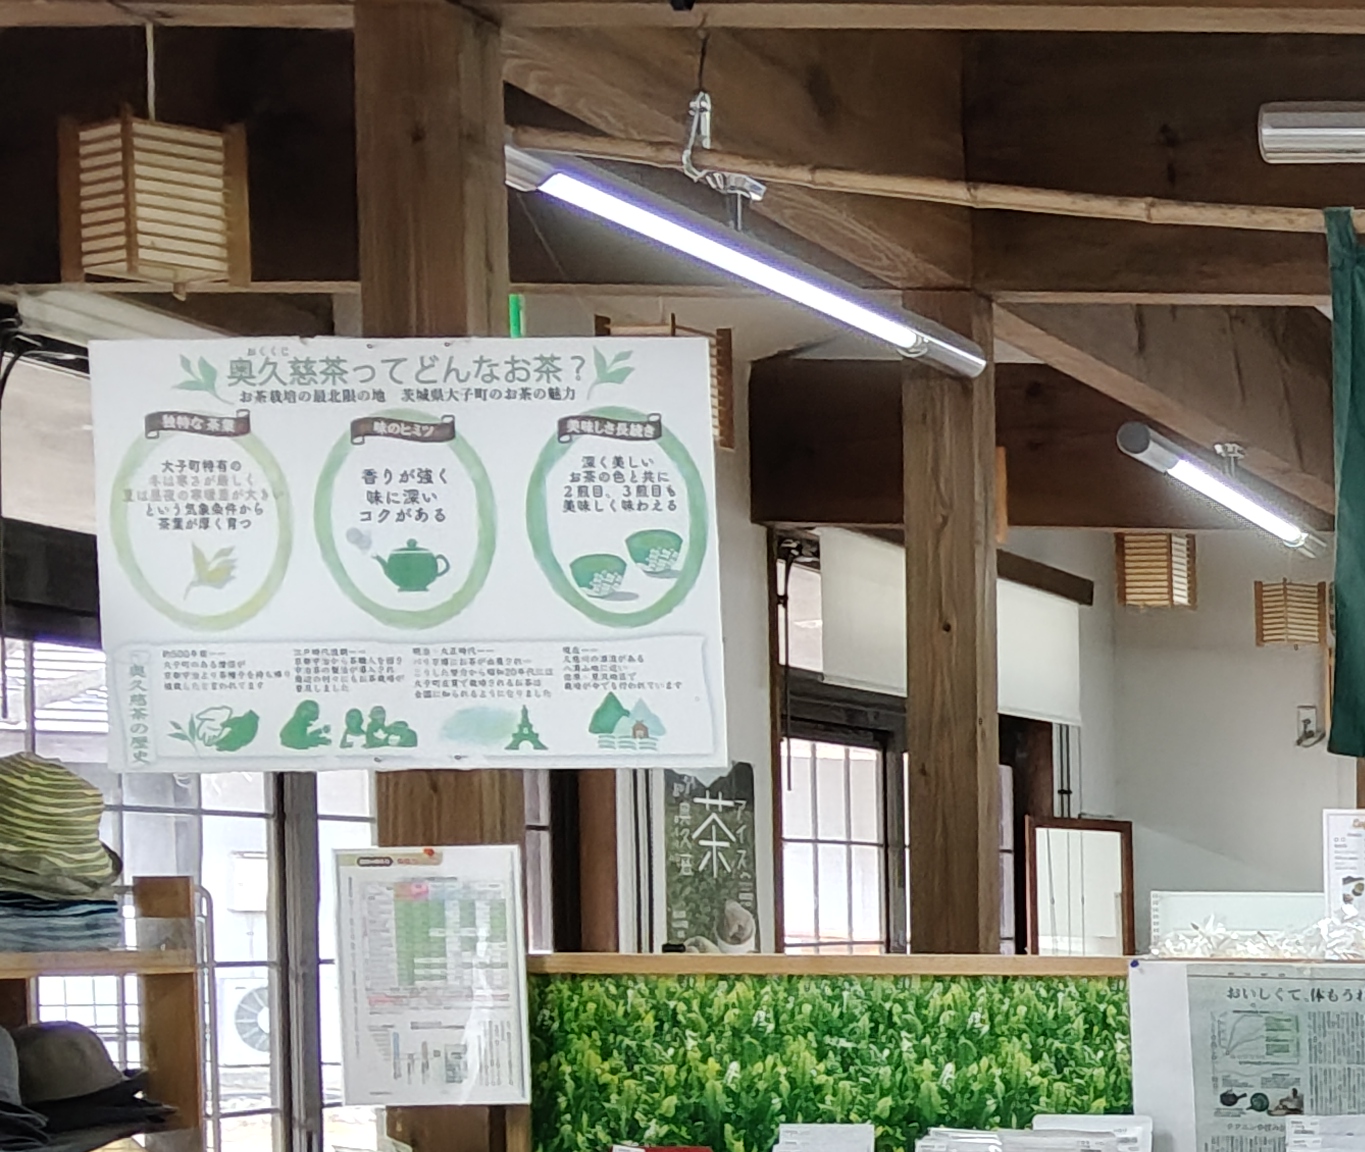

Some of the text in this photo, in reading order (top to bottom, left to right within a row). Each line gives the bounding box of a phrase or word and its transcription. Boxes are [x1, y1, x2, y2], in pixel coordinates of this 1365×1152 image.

[401, 387, 576, 402] 茨城県大子町のお茶の魅力
[373, 421, 435, 438] 味のヒミツ
[566, 418, 656, 438] 美味しさ長続き
[161, 460, 242, 473] 大子町特有の
[581, 456, 654, 469] 深く美しい
[362, 468, 449, 485] 香りが強く
[568, 470, 671, 484] お茶の色と共に
[366, 489, 438, 505] 味に深い
[146, 503, 264, 516] という気象条件から
[562, 499, 678, 513] 美味しく味わえる
[158, 517, 252, 530] 茶葉が厚く育つ
[359, 508, 447, 524] コクがある
[128, 663, 150, 765] 奥久慈茶の歴史
